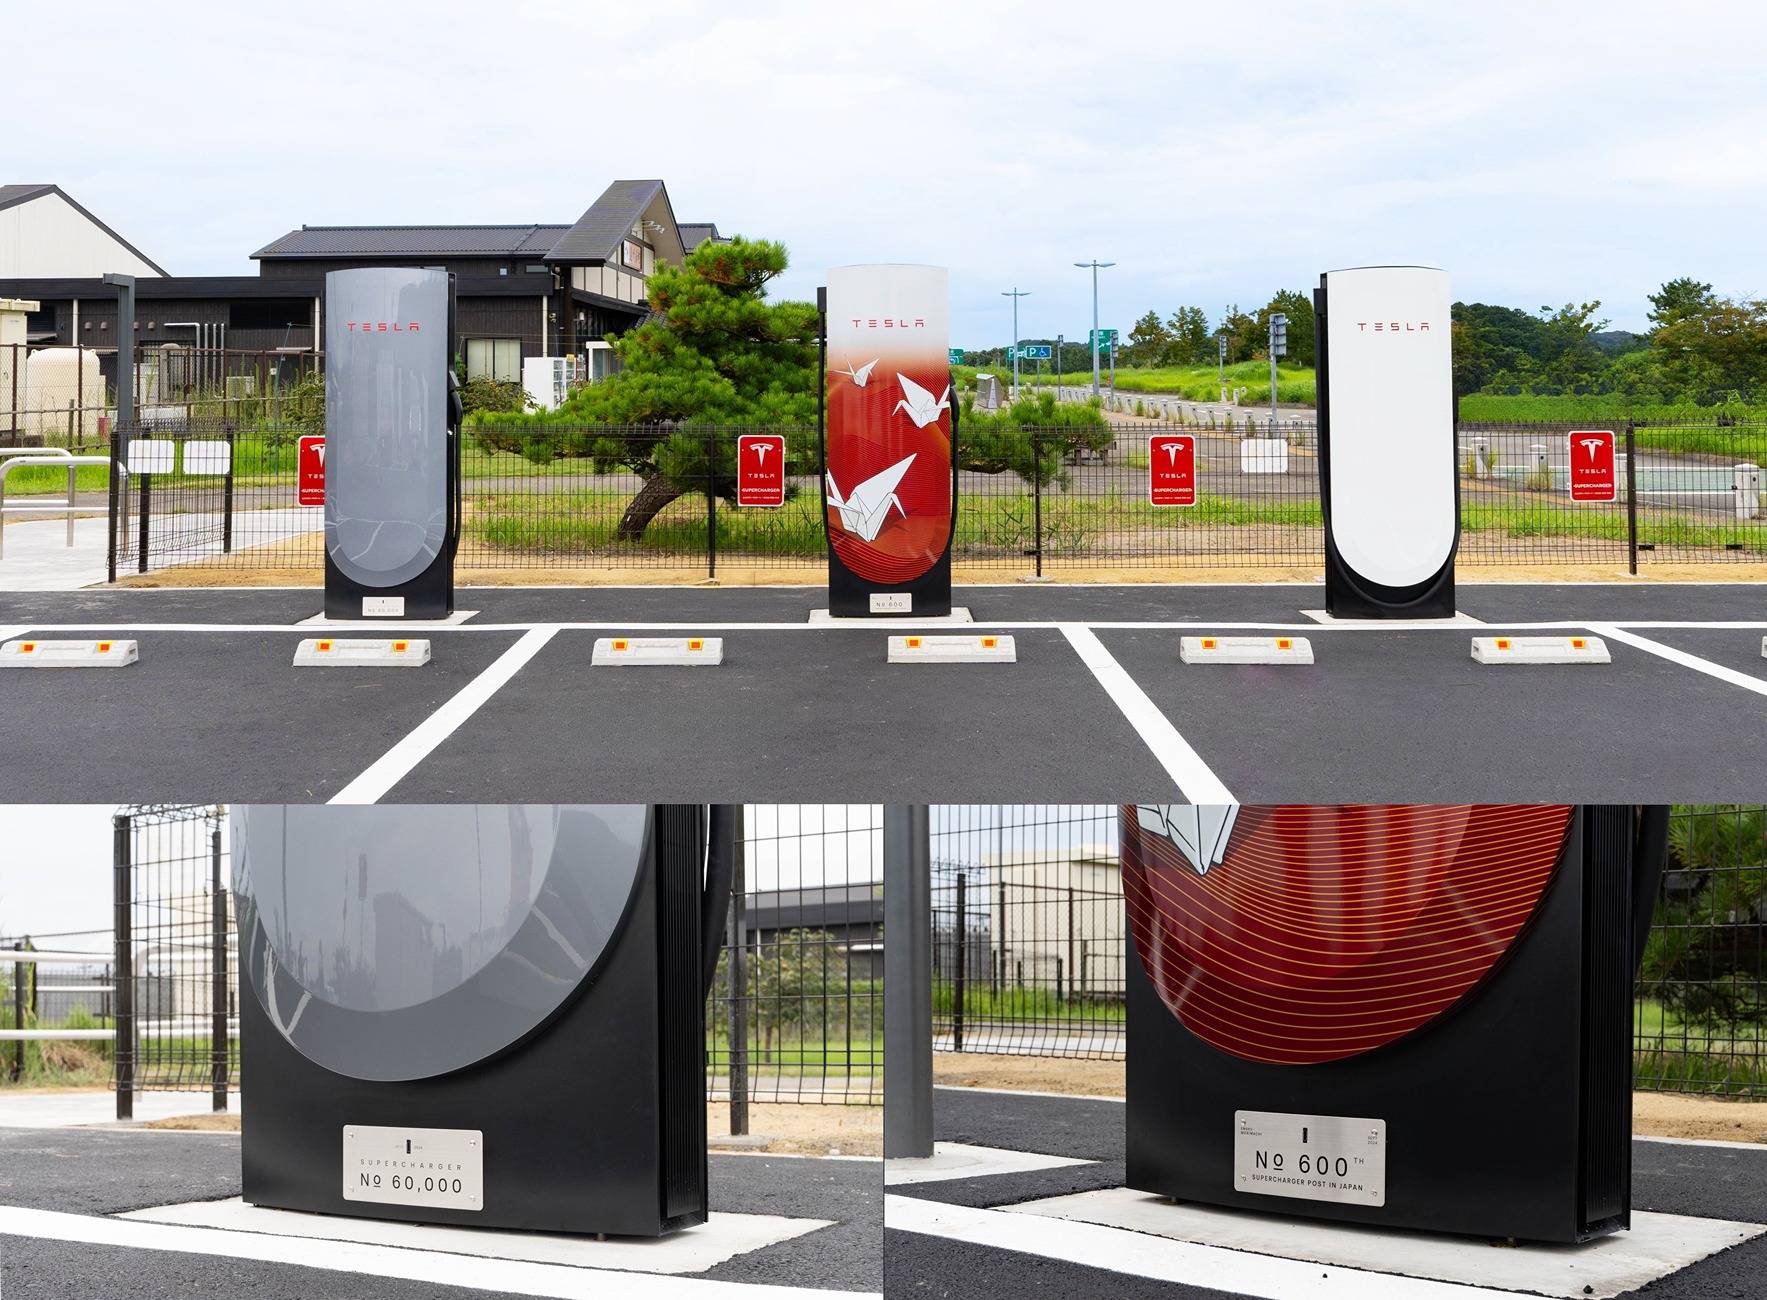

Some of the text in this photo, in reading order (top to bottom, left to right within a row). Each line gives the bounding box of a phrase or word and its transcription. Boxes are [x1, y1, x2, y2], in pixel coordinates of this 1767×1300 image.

[347, 322, 421, 331] TESLA
[852, 319, 924, 328] TESLA
[1357, 322, 1430, 331] TESLA
[1029, 347, 1037, 357] P
[360, 1158, 462, 1171] SUPERCHARGER
[392, 1174, 462, 1194] 60,000
[1251, 1174, 1364, 1192] SUPERCHARGER POST IN JAPAN
